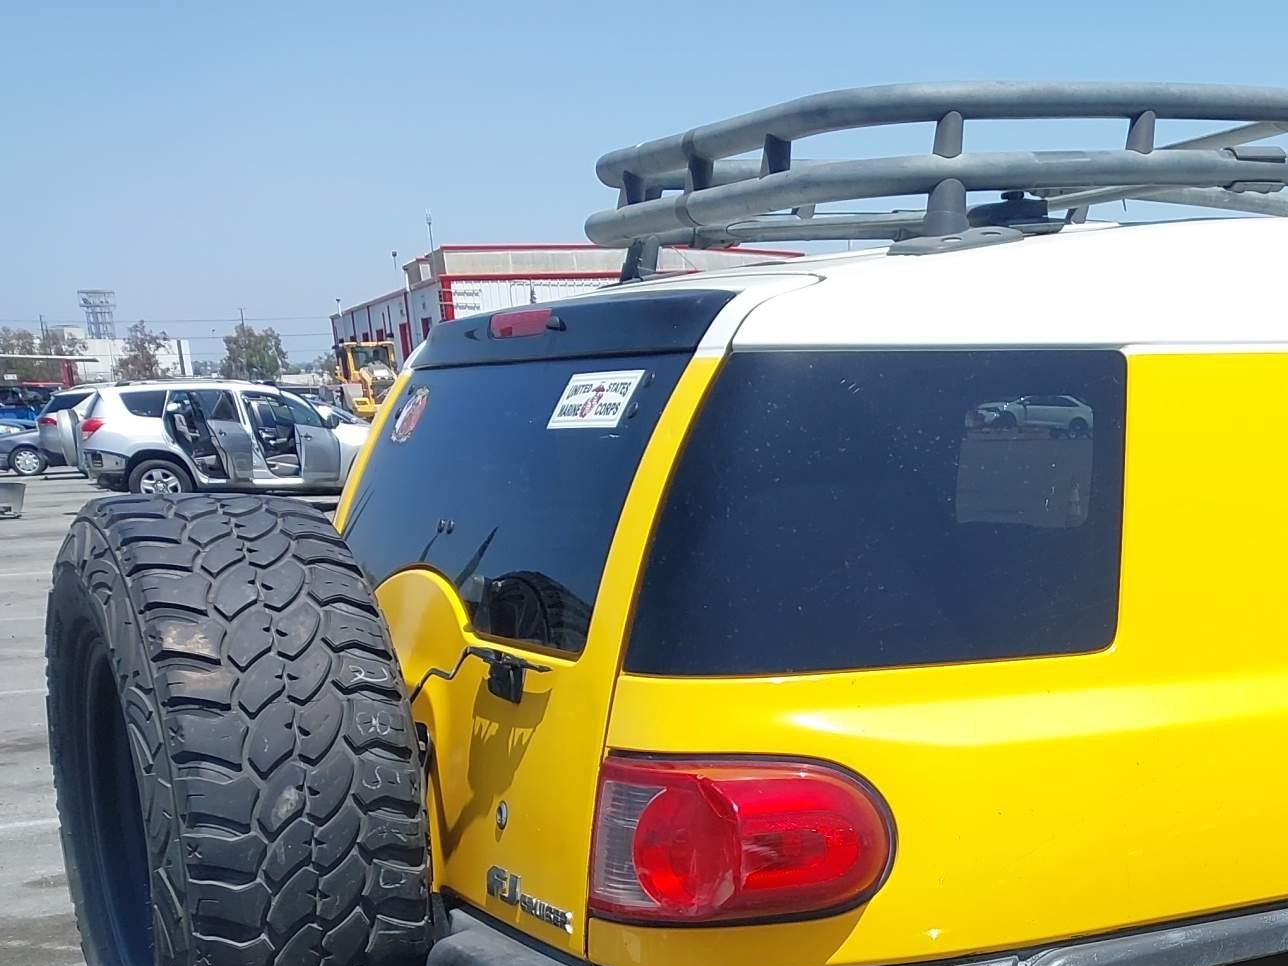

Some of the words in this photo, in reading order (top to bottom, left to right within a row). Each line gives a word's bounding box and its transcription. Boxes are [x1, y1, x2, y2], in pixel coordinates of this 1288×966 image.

[566, 383, 593, 400] UNITED
[607, 381, 632, 398] STATES
[557, 403, 582, 418] MARINE
[594, 402, 621, 416] CORPS
[486, 865, 521, 906] FJ
